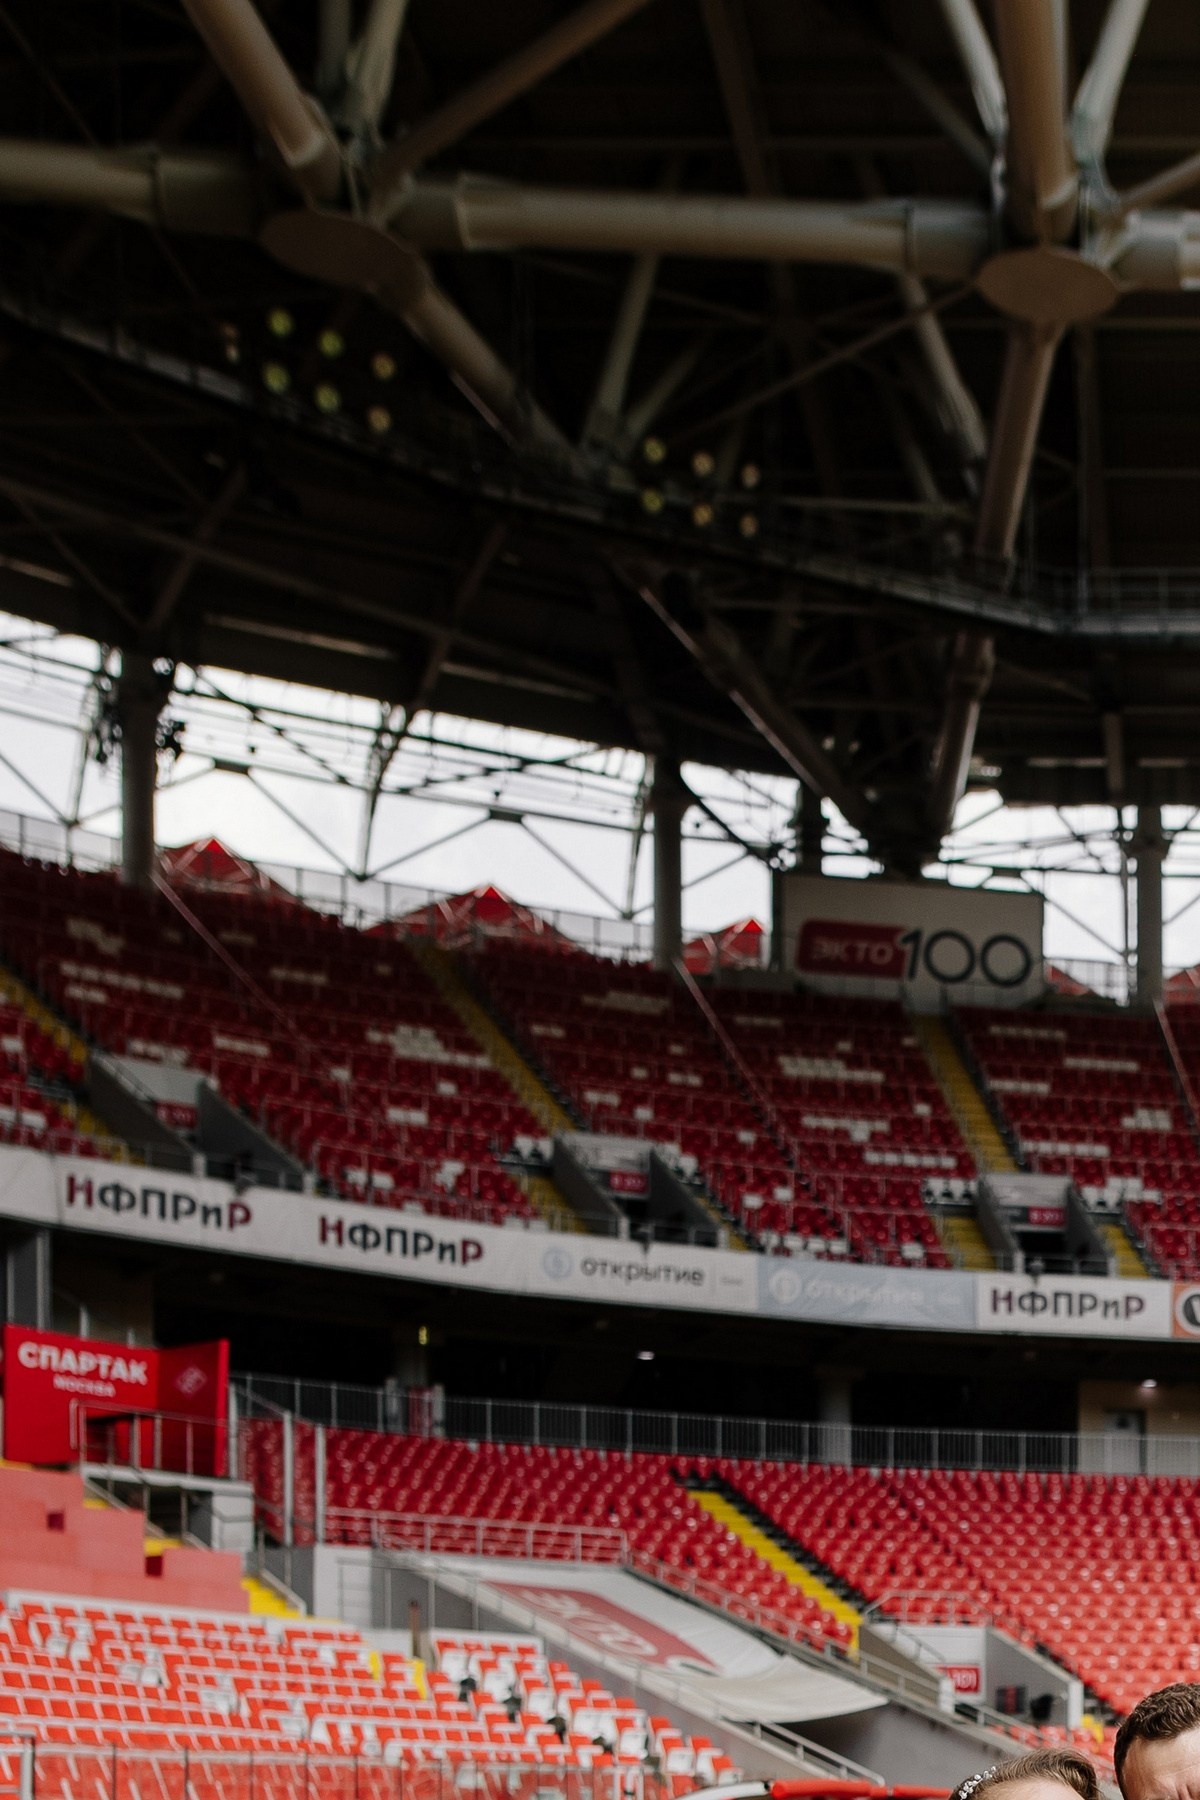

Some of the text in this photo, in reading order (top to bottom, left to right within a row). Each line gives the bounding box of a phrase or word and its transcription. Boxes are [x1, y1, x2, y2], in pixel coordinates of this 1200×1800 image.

[902, 928, 1032, 987] 100
[66, 1173, 253, 1231] НФПРиР
[319, 1215, 484, 1266] НФПРиР
[990, 1288, 1146, 1321] НФПРиР
[17, 1340, 149, 1386] СПАРТАК
